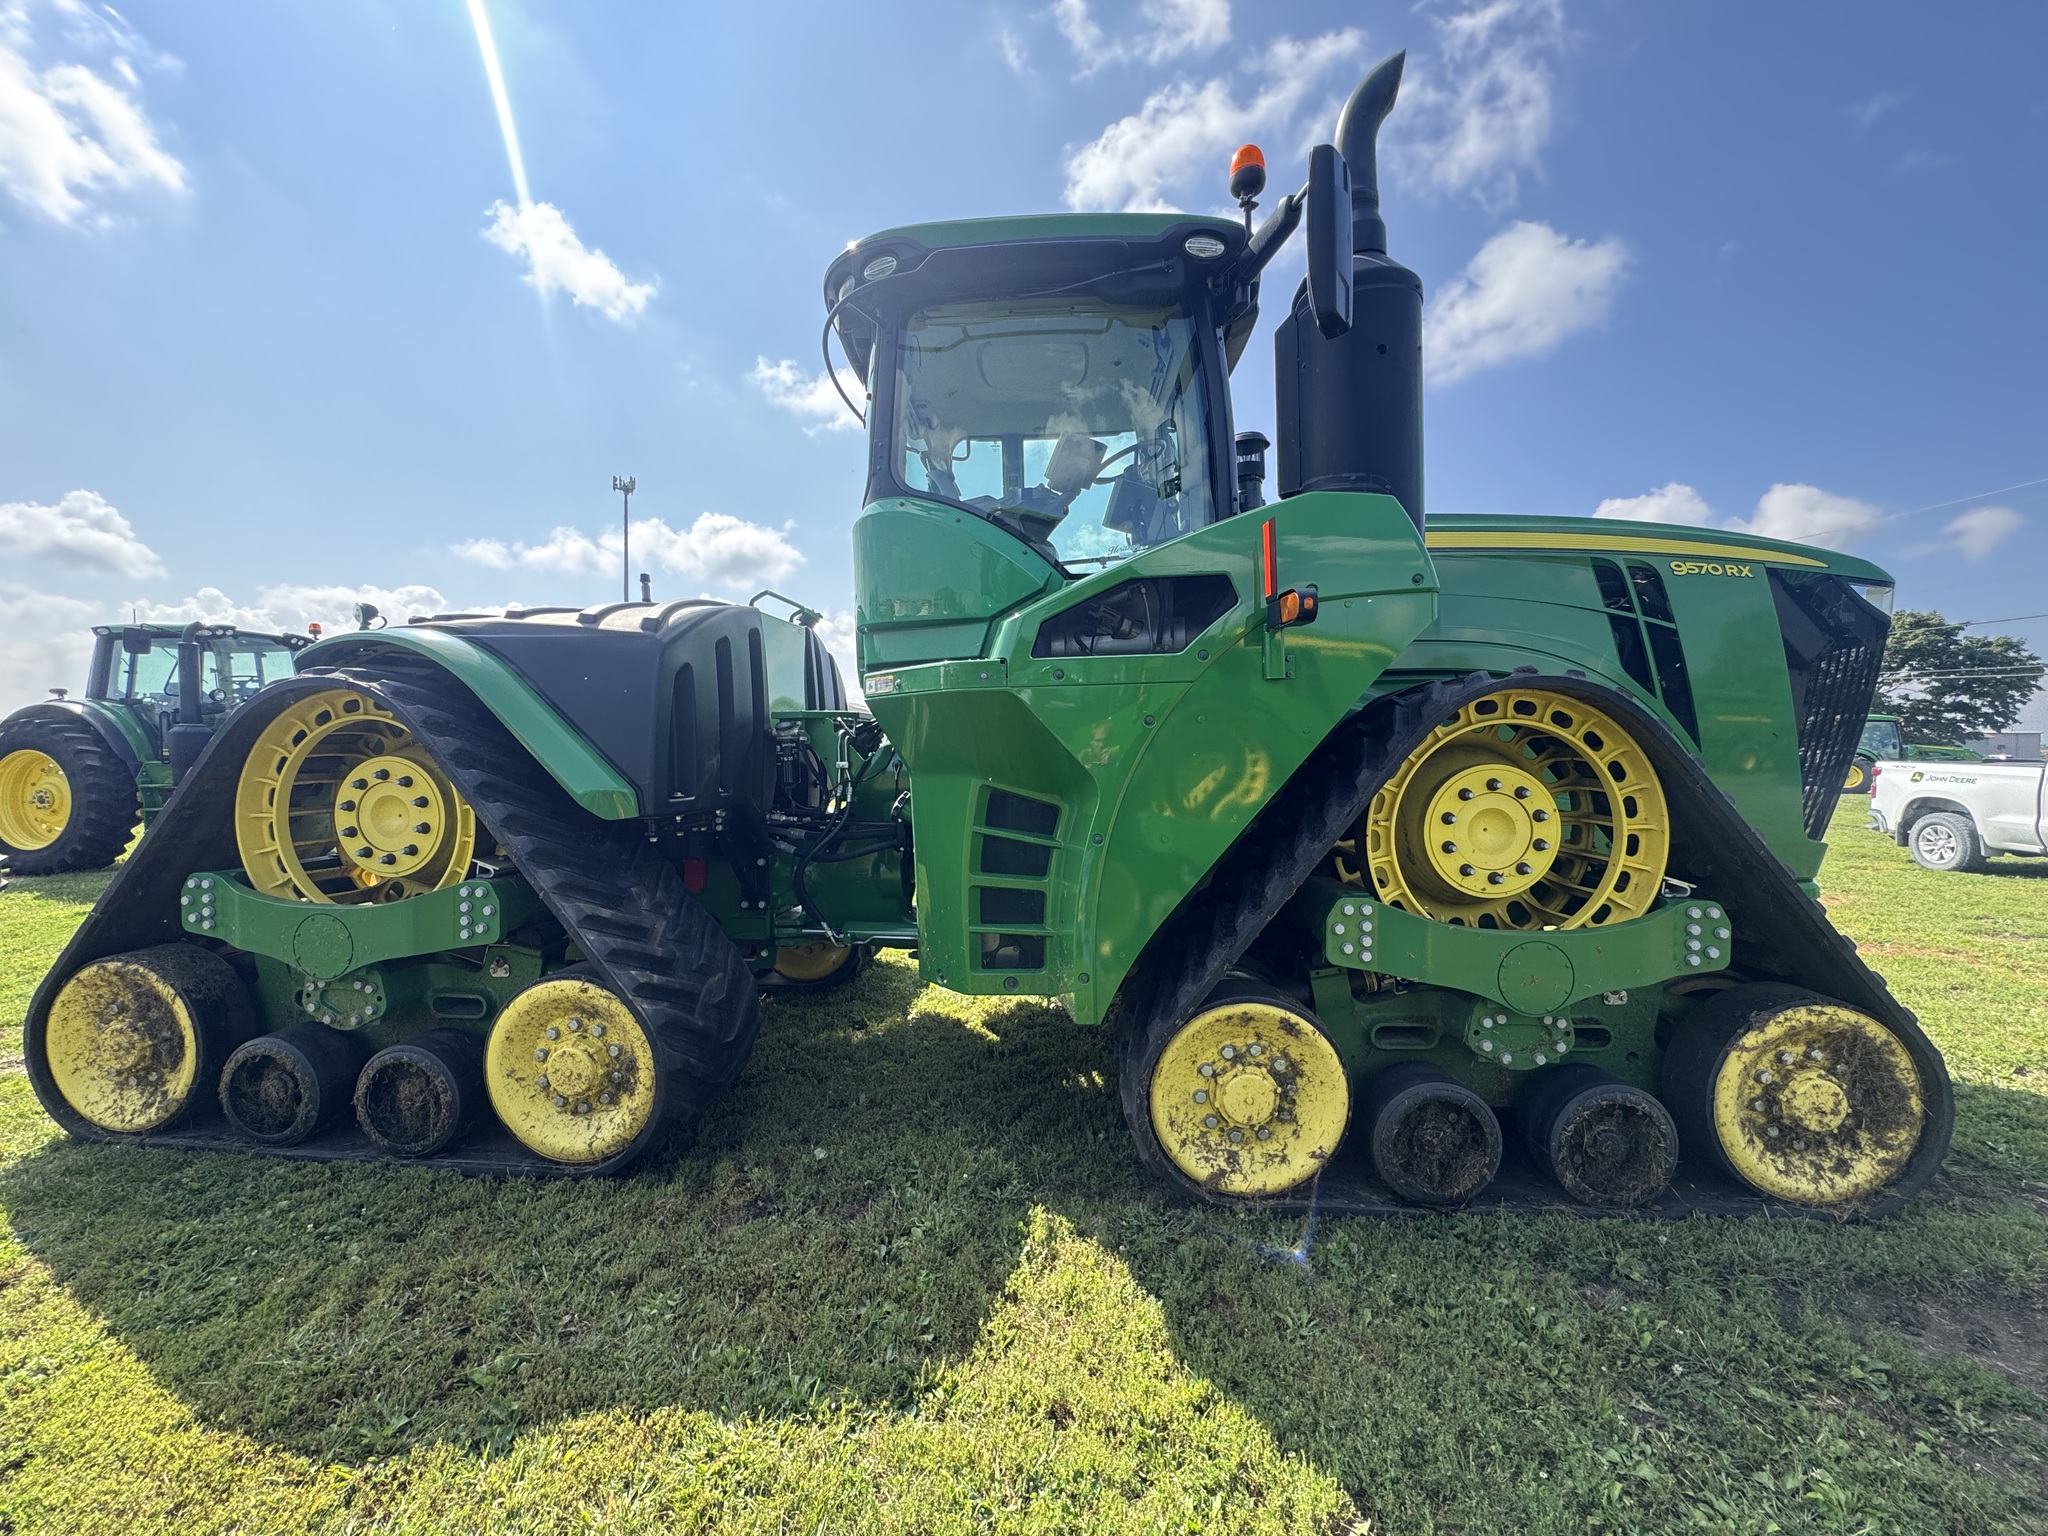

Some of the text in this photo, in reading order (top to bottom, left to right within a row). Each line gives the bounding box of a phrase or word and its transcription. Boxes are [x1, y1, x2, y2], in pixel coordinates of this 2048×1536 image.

[1669, 561, 1755, 578] 9570 RX
[1948, 776, 1978, 784] DEERE
